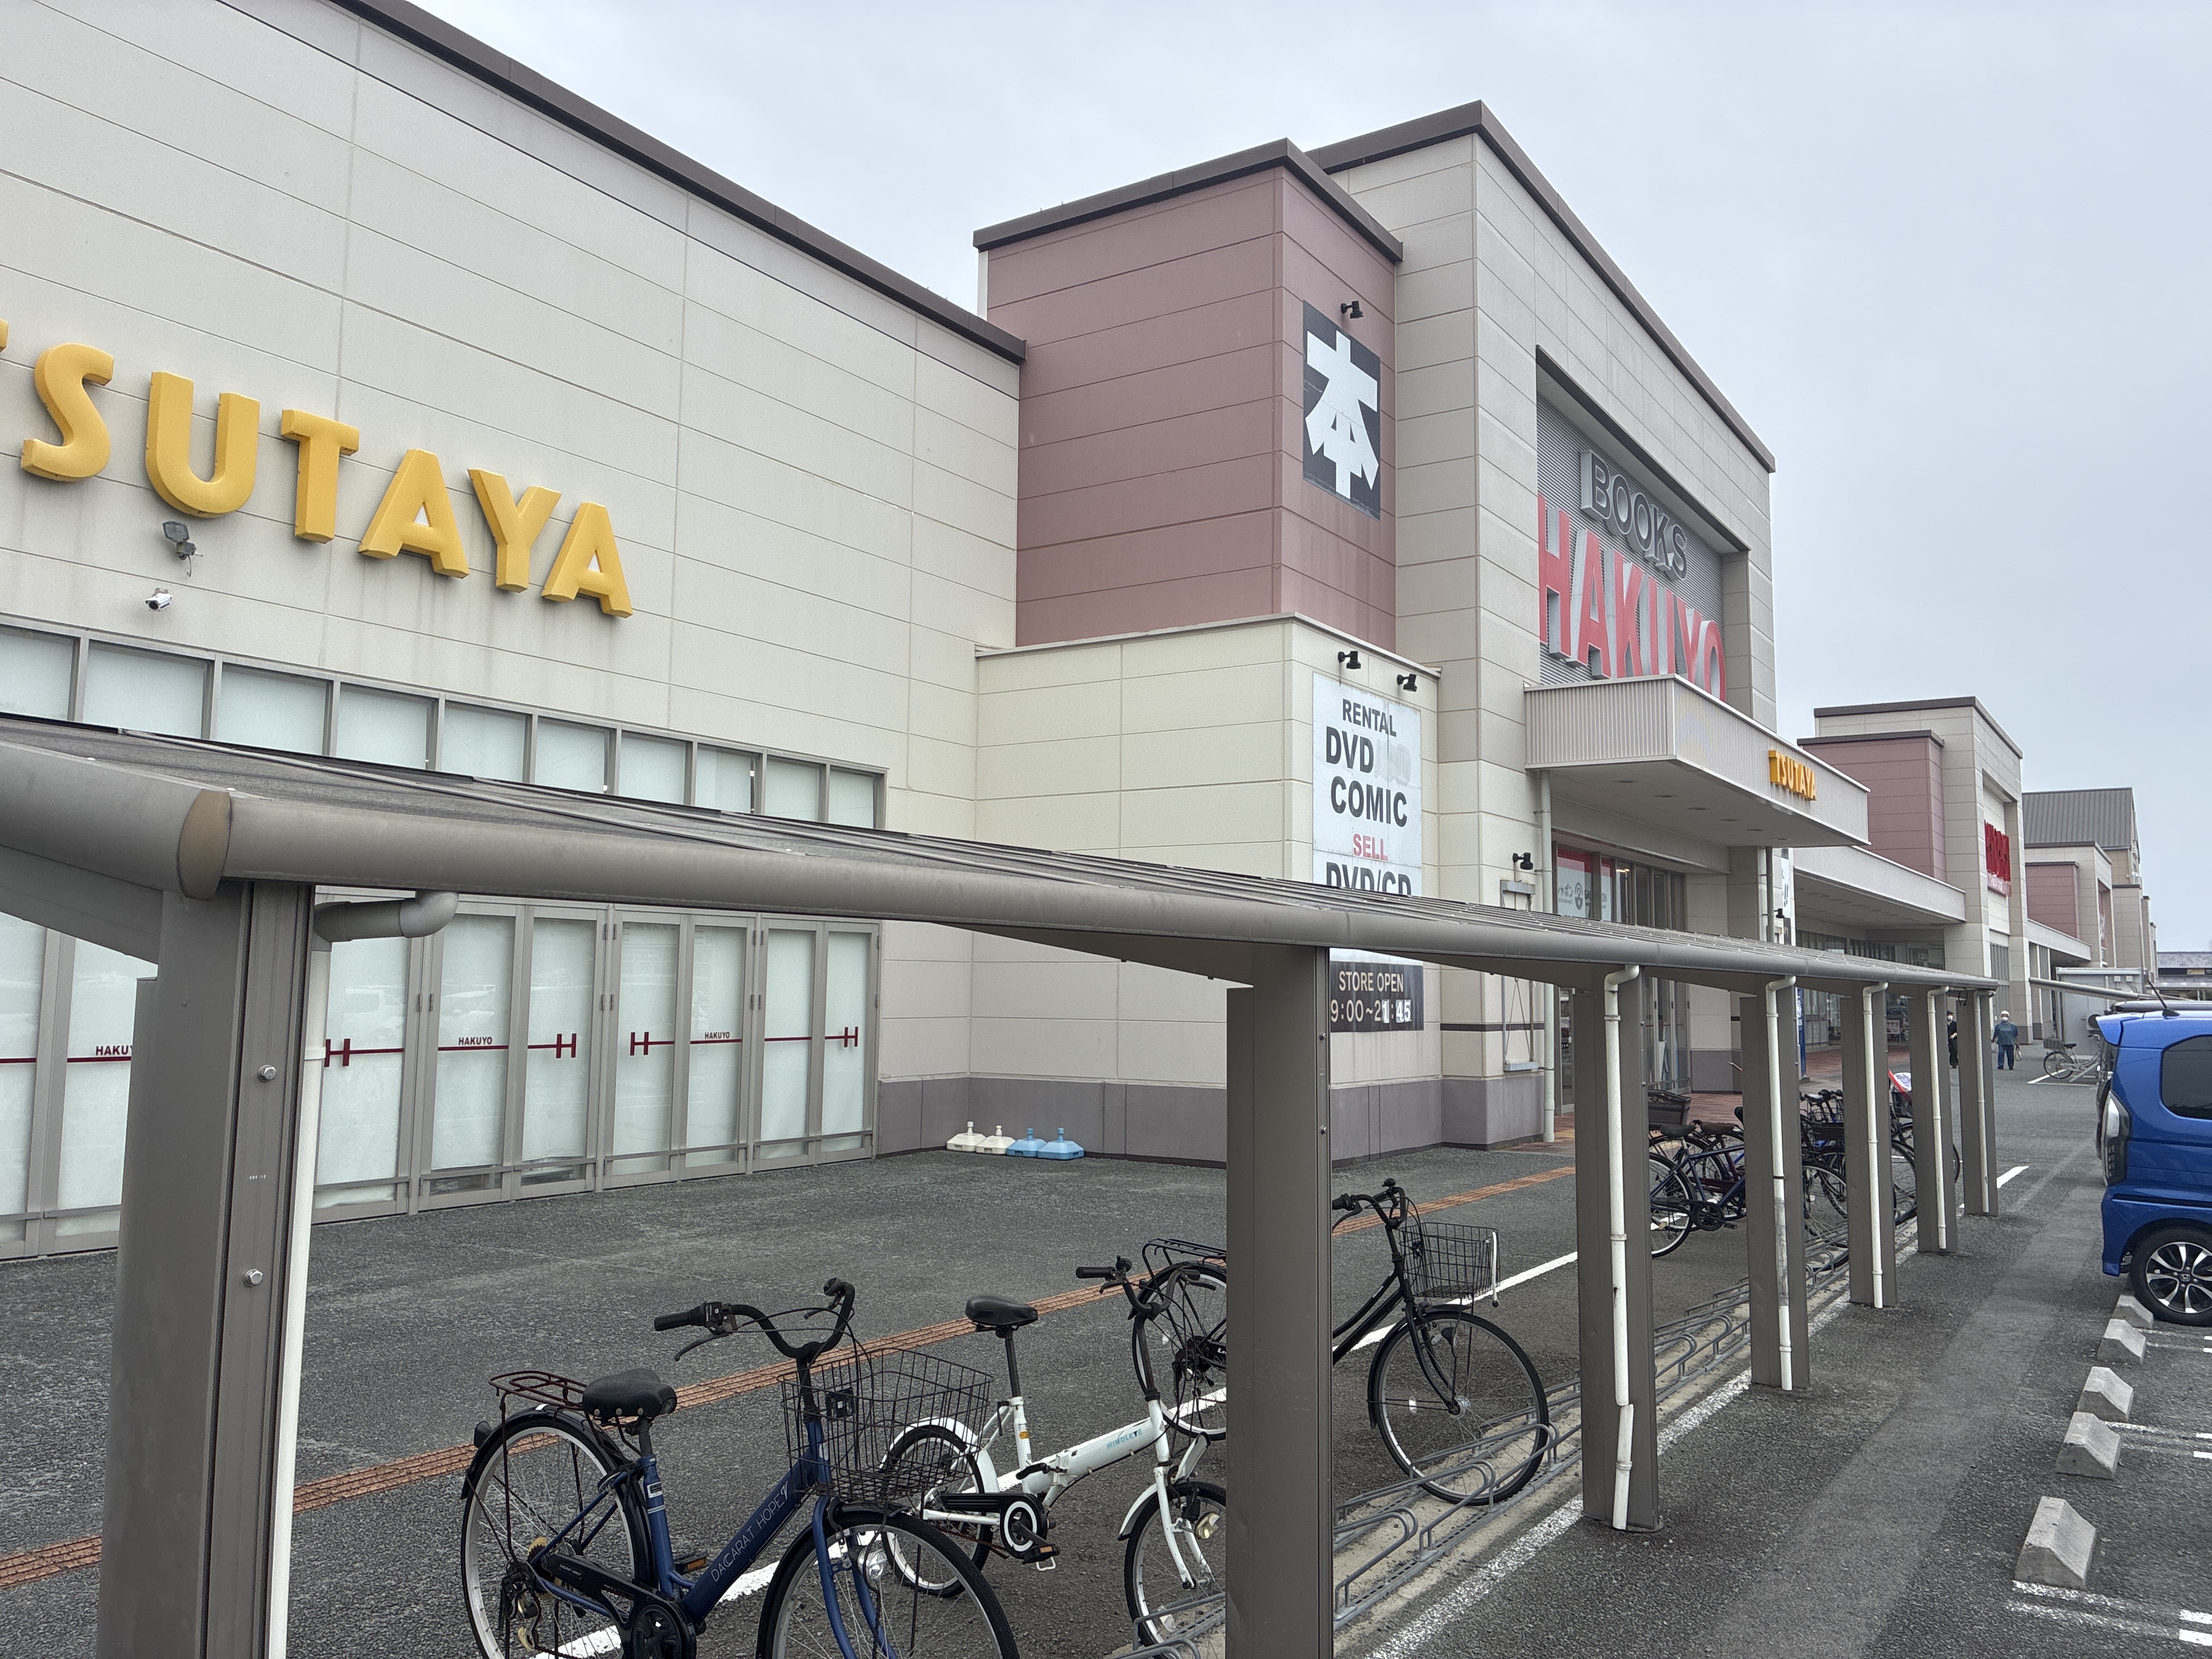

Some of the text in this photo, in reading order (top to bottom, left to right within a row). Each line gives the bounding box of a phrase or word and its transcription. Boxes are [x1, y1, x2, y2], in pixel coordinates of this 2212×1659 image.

[1305, 330, 1379, 499] 本
[0, 319, 633, 618] SUTAYA
[1581, 449, 1687, 581] BOOKS
[1538, 493, 1726, 703] HAKUYO
[1342, 698, 1397, 737] RENTAL
[1326, 725, 1374, 774] DVD
[1768, 749, 1817, 801] TSUTAYA
[1330, 775, 1408, 827] COMIC
[1353, 833, 1388, 861] SELL
[1339, 970, 1404, 992] STORE OPEN
[95, 1045, 132, 1056] HAKU
[458, 1036, 493, 1045] HAKUYO
[704, 1031, 730, 1040] HAKUYO
[756, 1493, 785, 1529] HOPE
